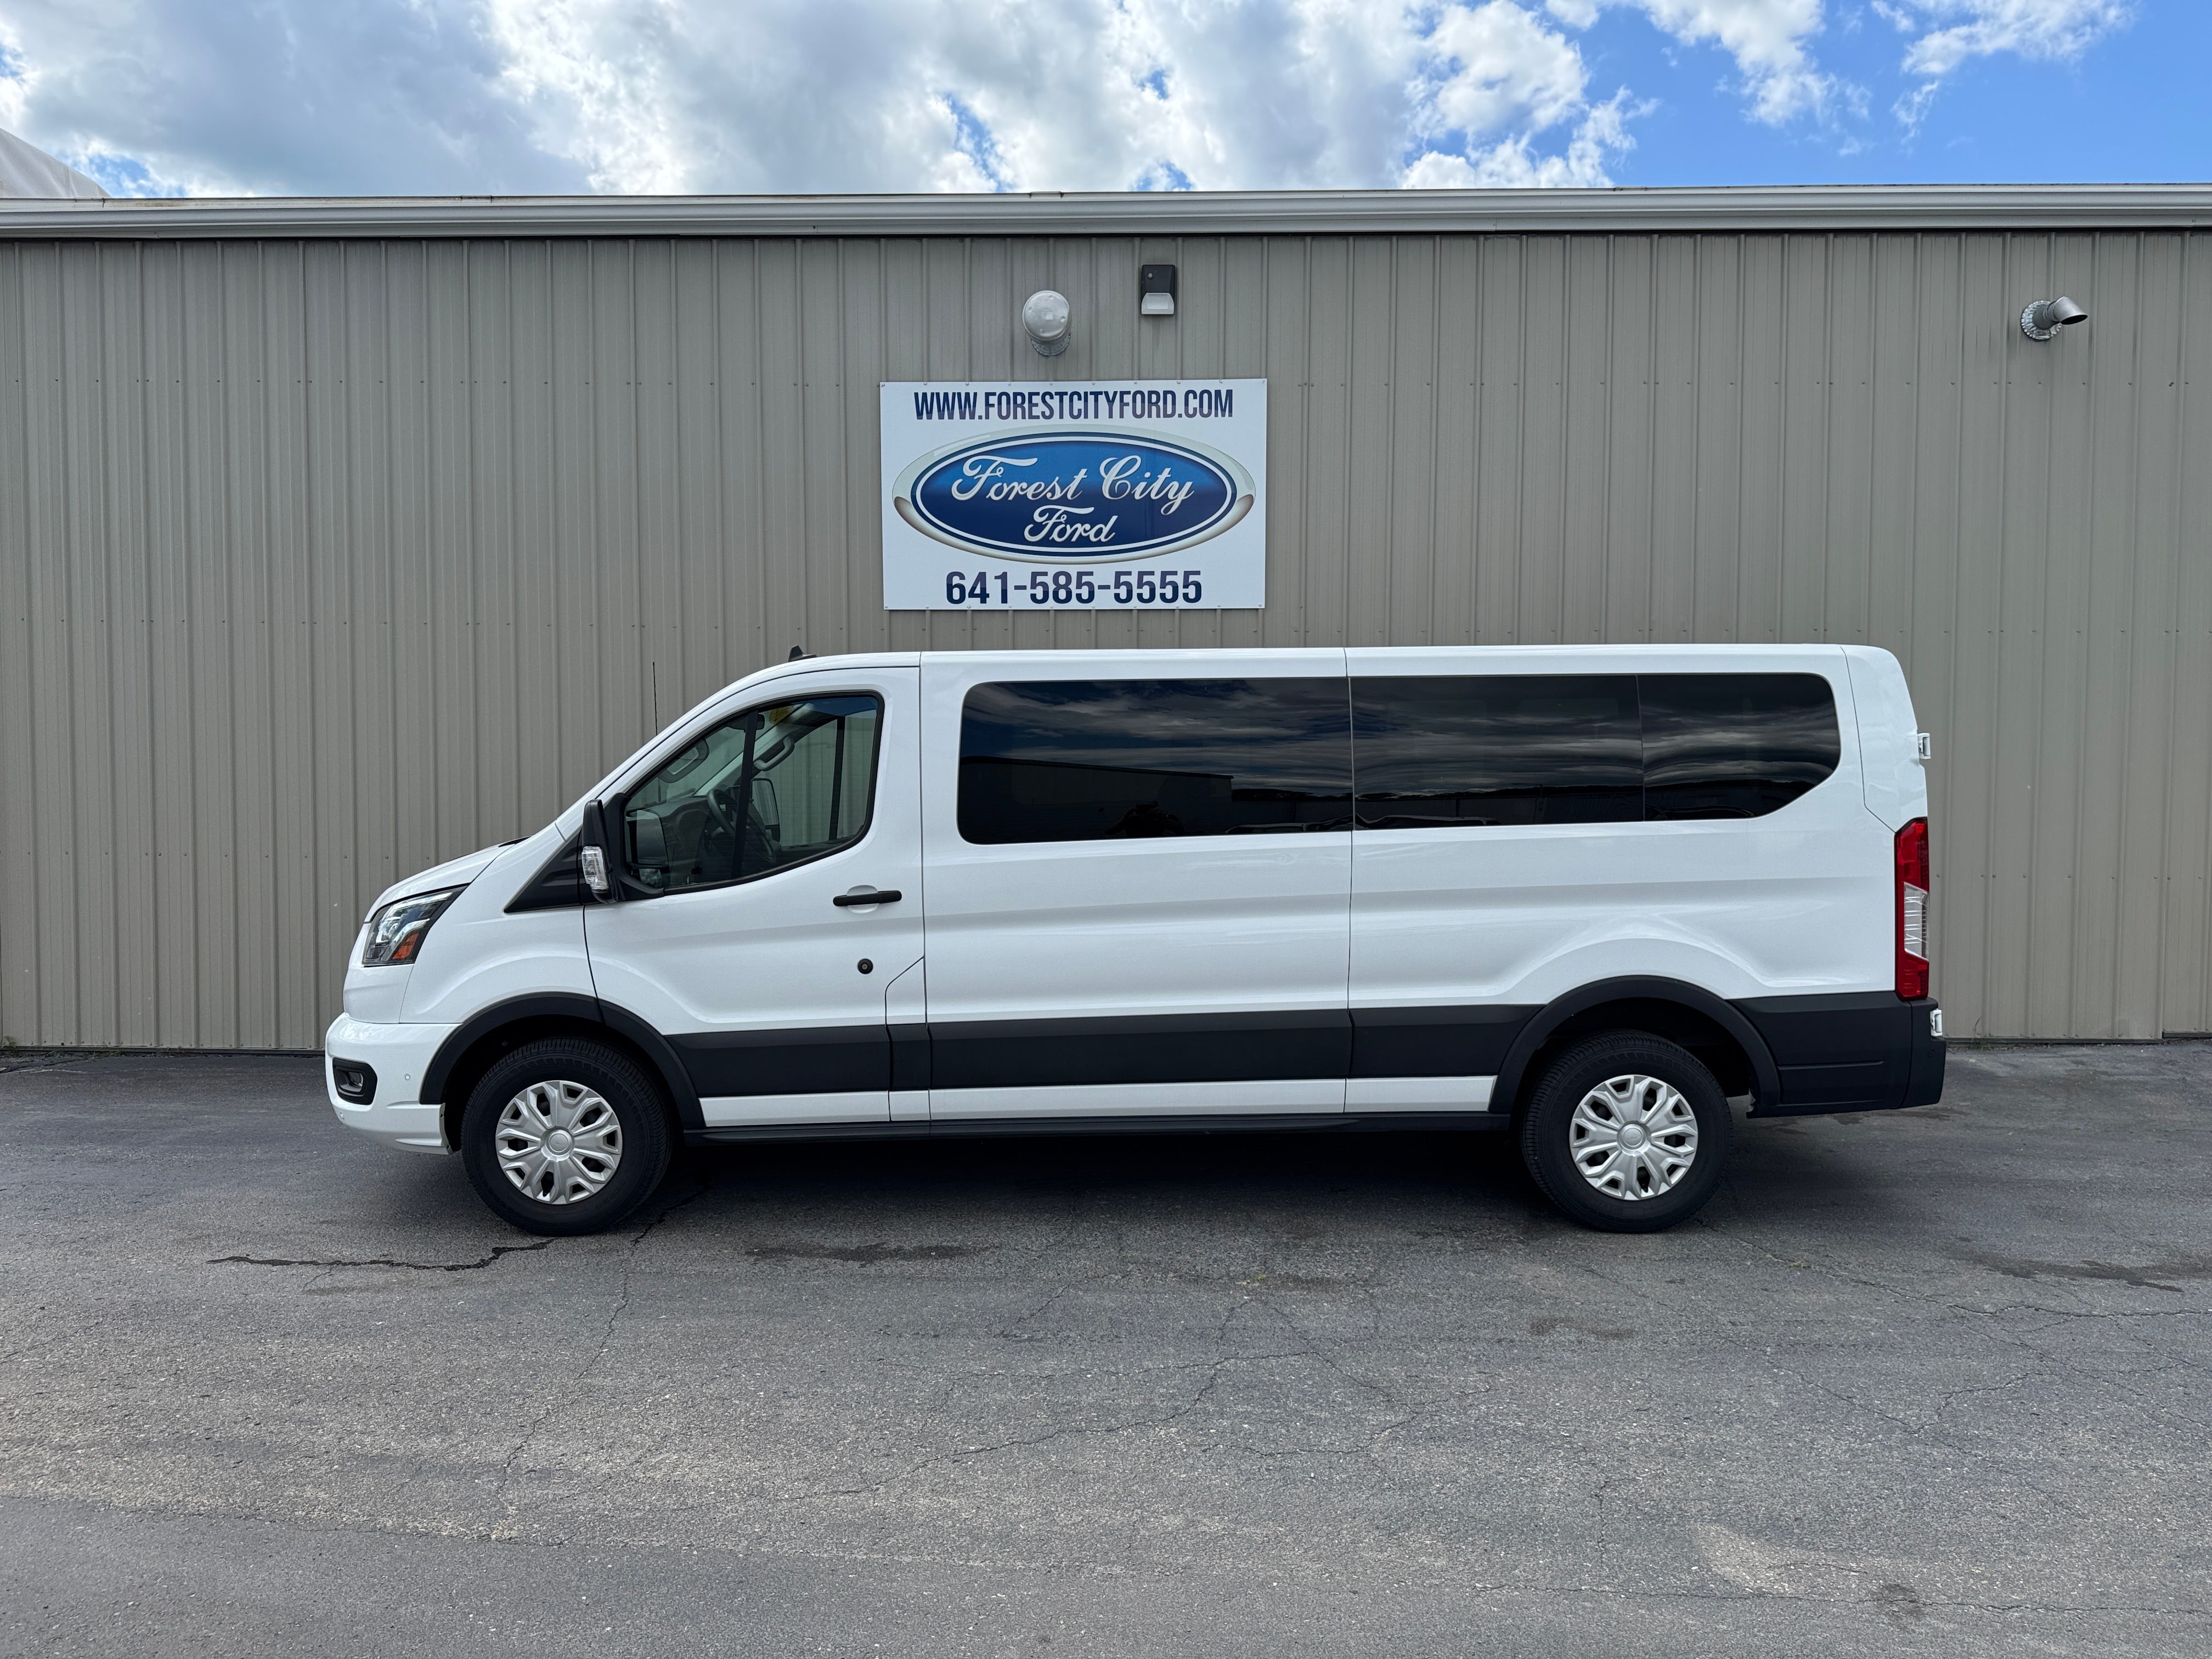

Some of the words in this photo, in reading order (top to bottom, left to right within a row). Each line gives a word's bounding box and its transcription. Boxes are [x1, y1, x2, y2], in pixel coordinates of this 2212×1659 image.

[914, 390, 1233, 420] WWW.FORESTCITYFORD.COM
[952, 455, 1087, 500] Forest
[1100, 455, 1195, 515] City
[1024, 505, 1118, 542] Ford
[946, 571, 1202, 604] 641-585-5555
